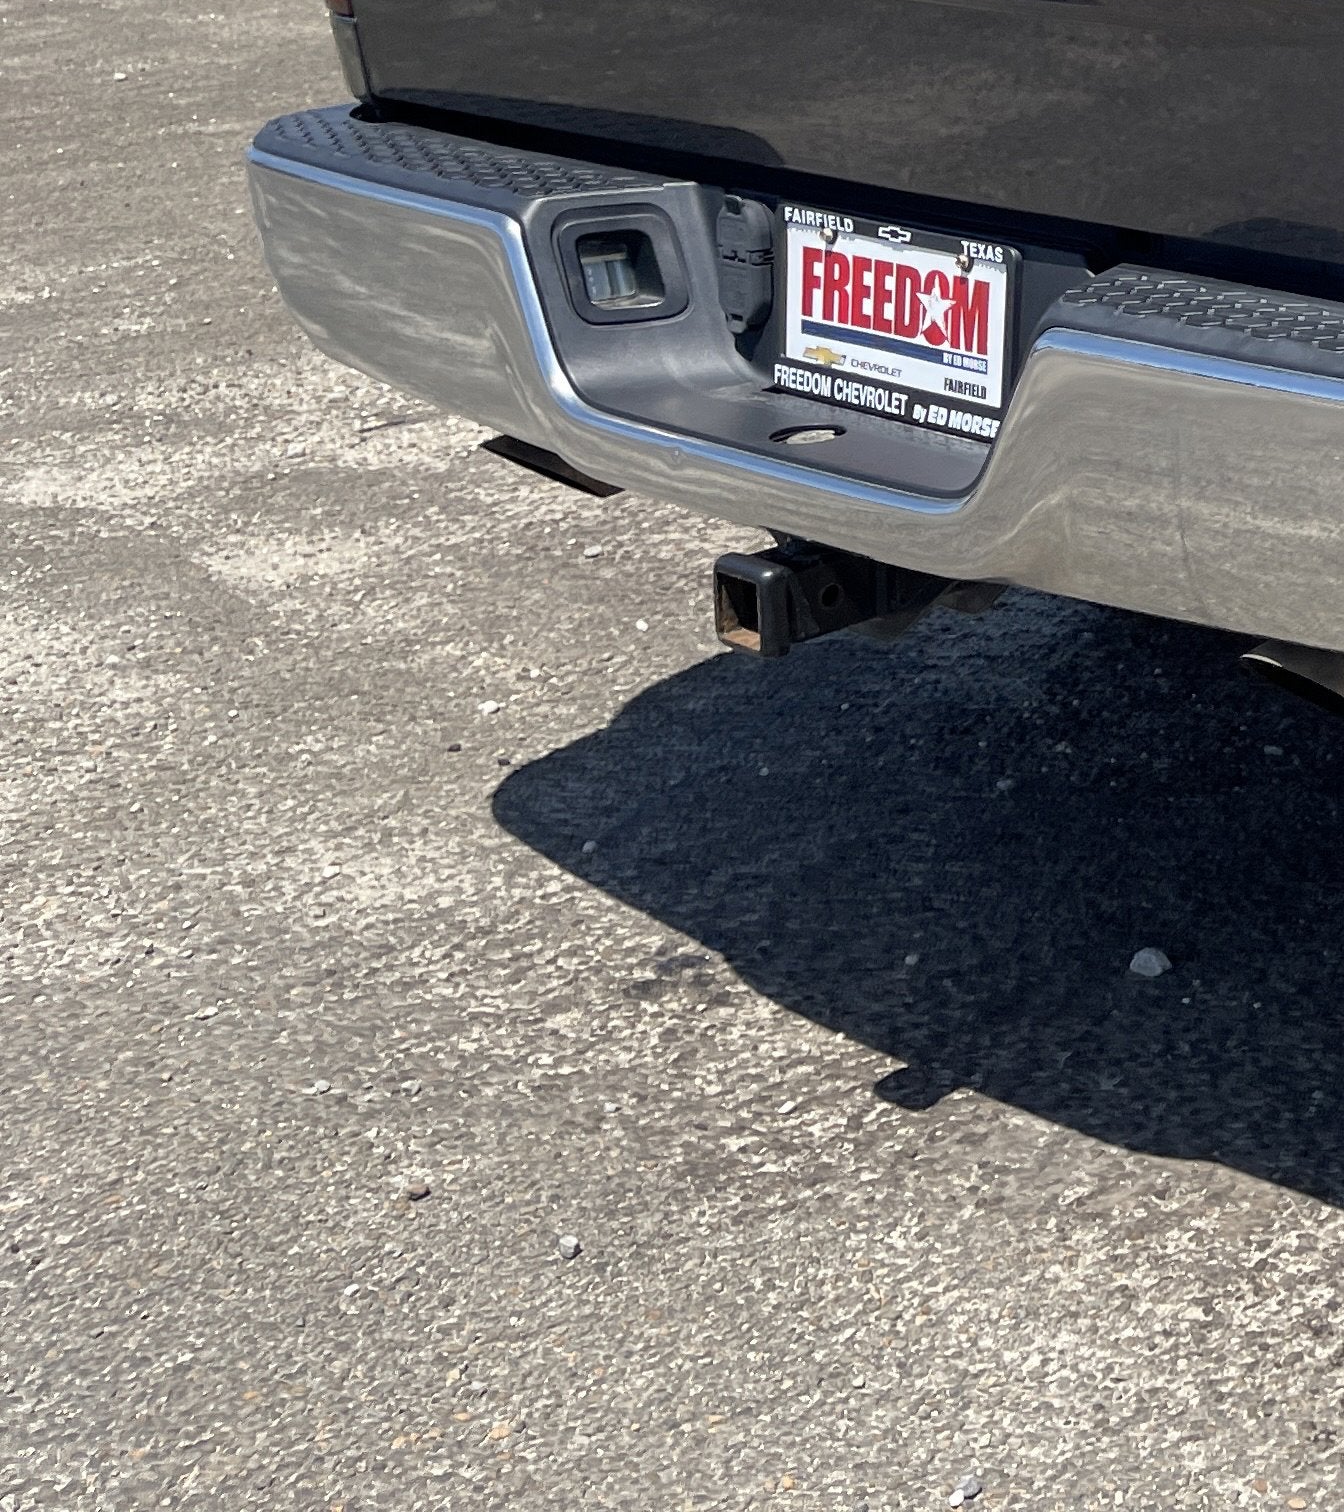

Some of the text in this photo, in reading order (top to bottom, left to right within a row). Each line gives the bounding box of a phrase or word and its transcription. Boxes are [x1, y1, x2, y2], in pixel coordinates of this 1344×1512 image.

[784, 206, 1004, 263] FAIRFIELD TEXAS
[801, 245, 991, 356] FREEDOM
[850, 358, 903, 378] CHEVROLET
[943, 377, 987, 400] FAIRFIELD
[773, 364, 1001, 438] FREEDOM CHEVROLET By ED MORSE
